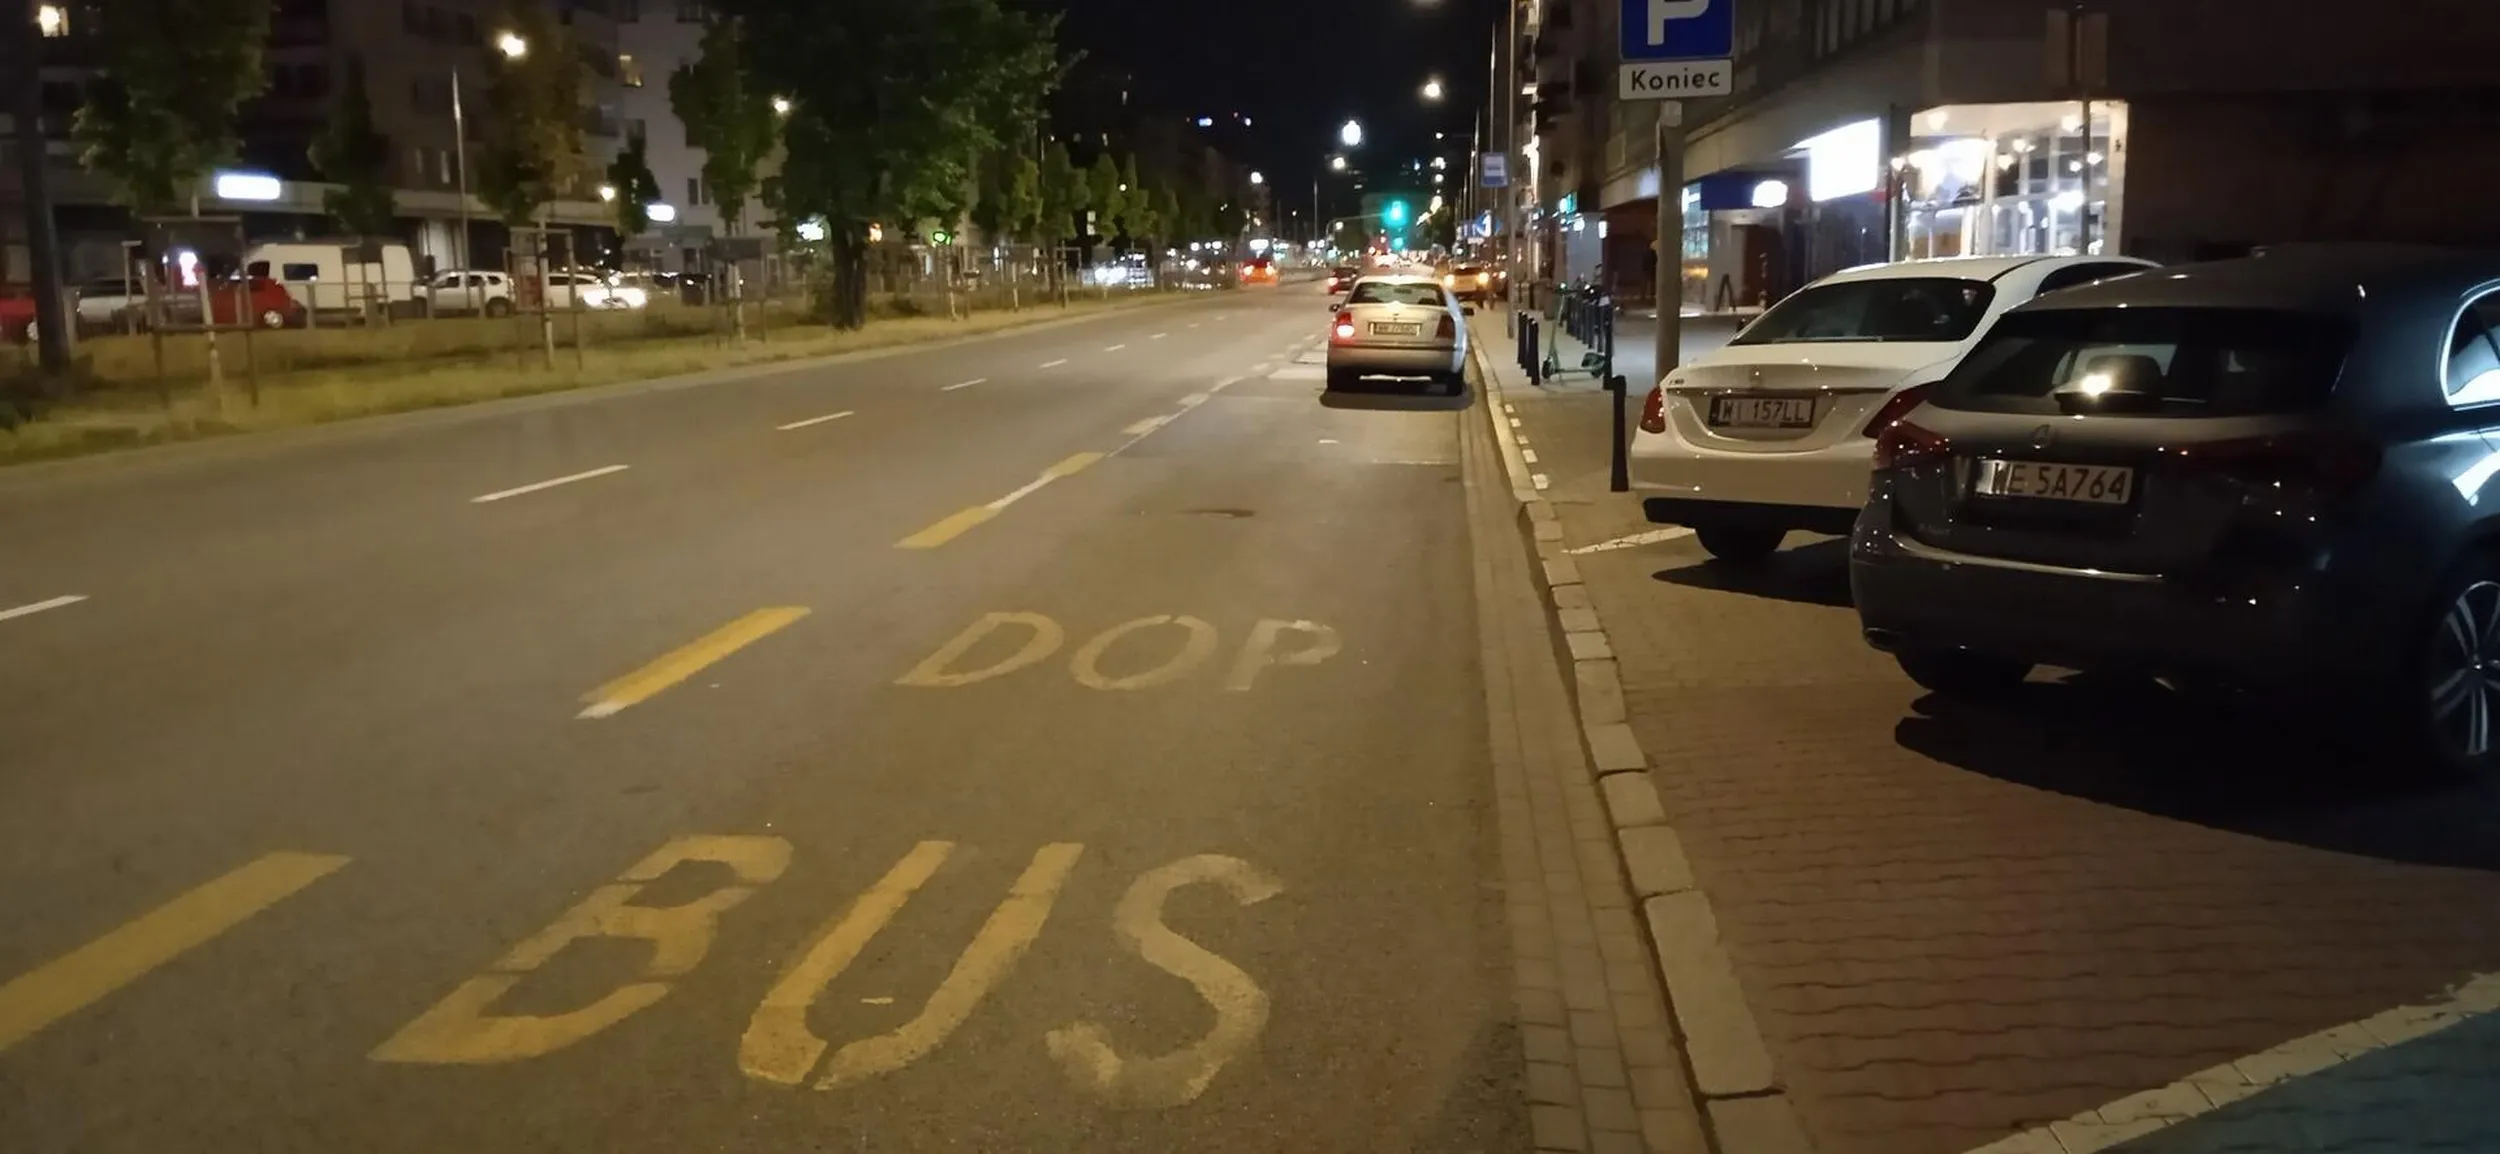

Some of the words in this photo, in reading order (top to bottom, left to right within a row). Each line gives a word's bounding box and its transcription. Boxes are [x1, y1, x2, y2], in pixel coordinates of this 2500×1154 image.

[1631, 68, 1720, 91] Koniec
[1753, 401, 1804, 422] 157LL
[1992, 462, 2027, 494] WE
[2035, 466, 2127, 501] 5A764
[893, 611, 1343, 691] DOP
[368, 835, 1284, 1107] BUS
